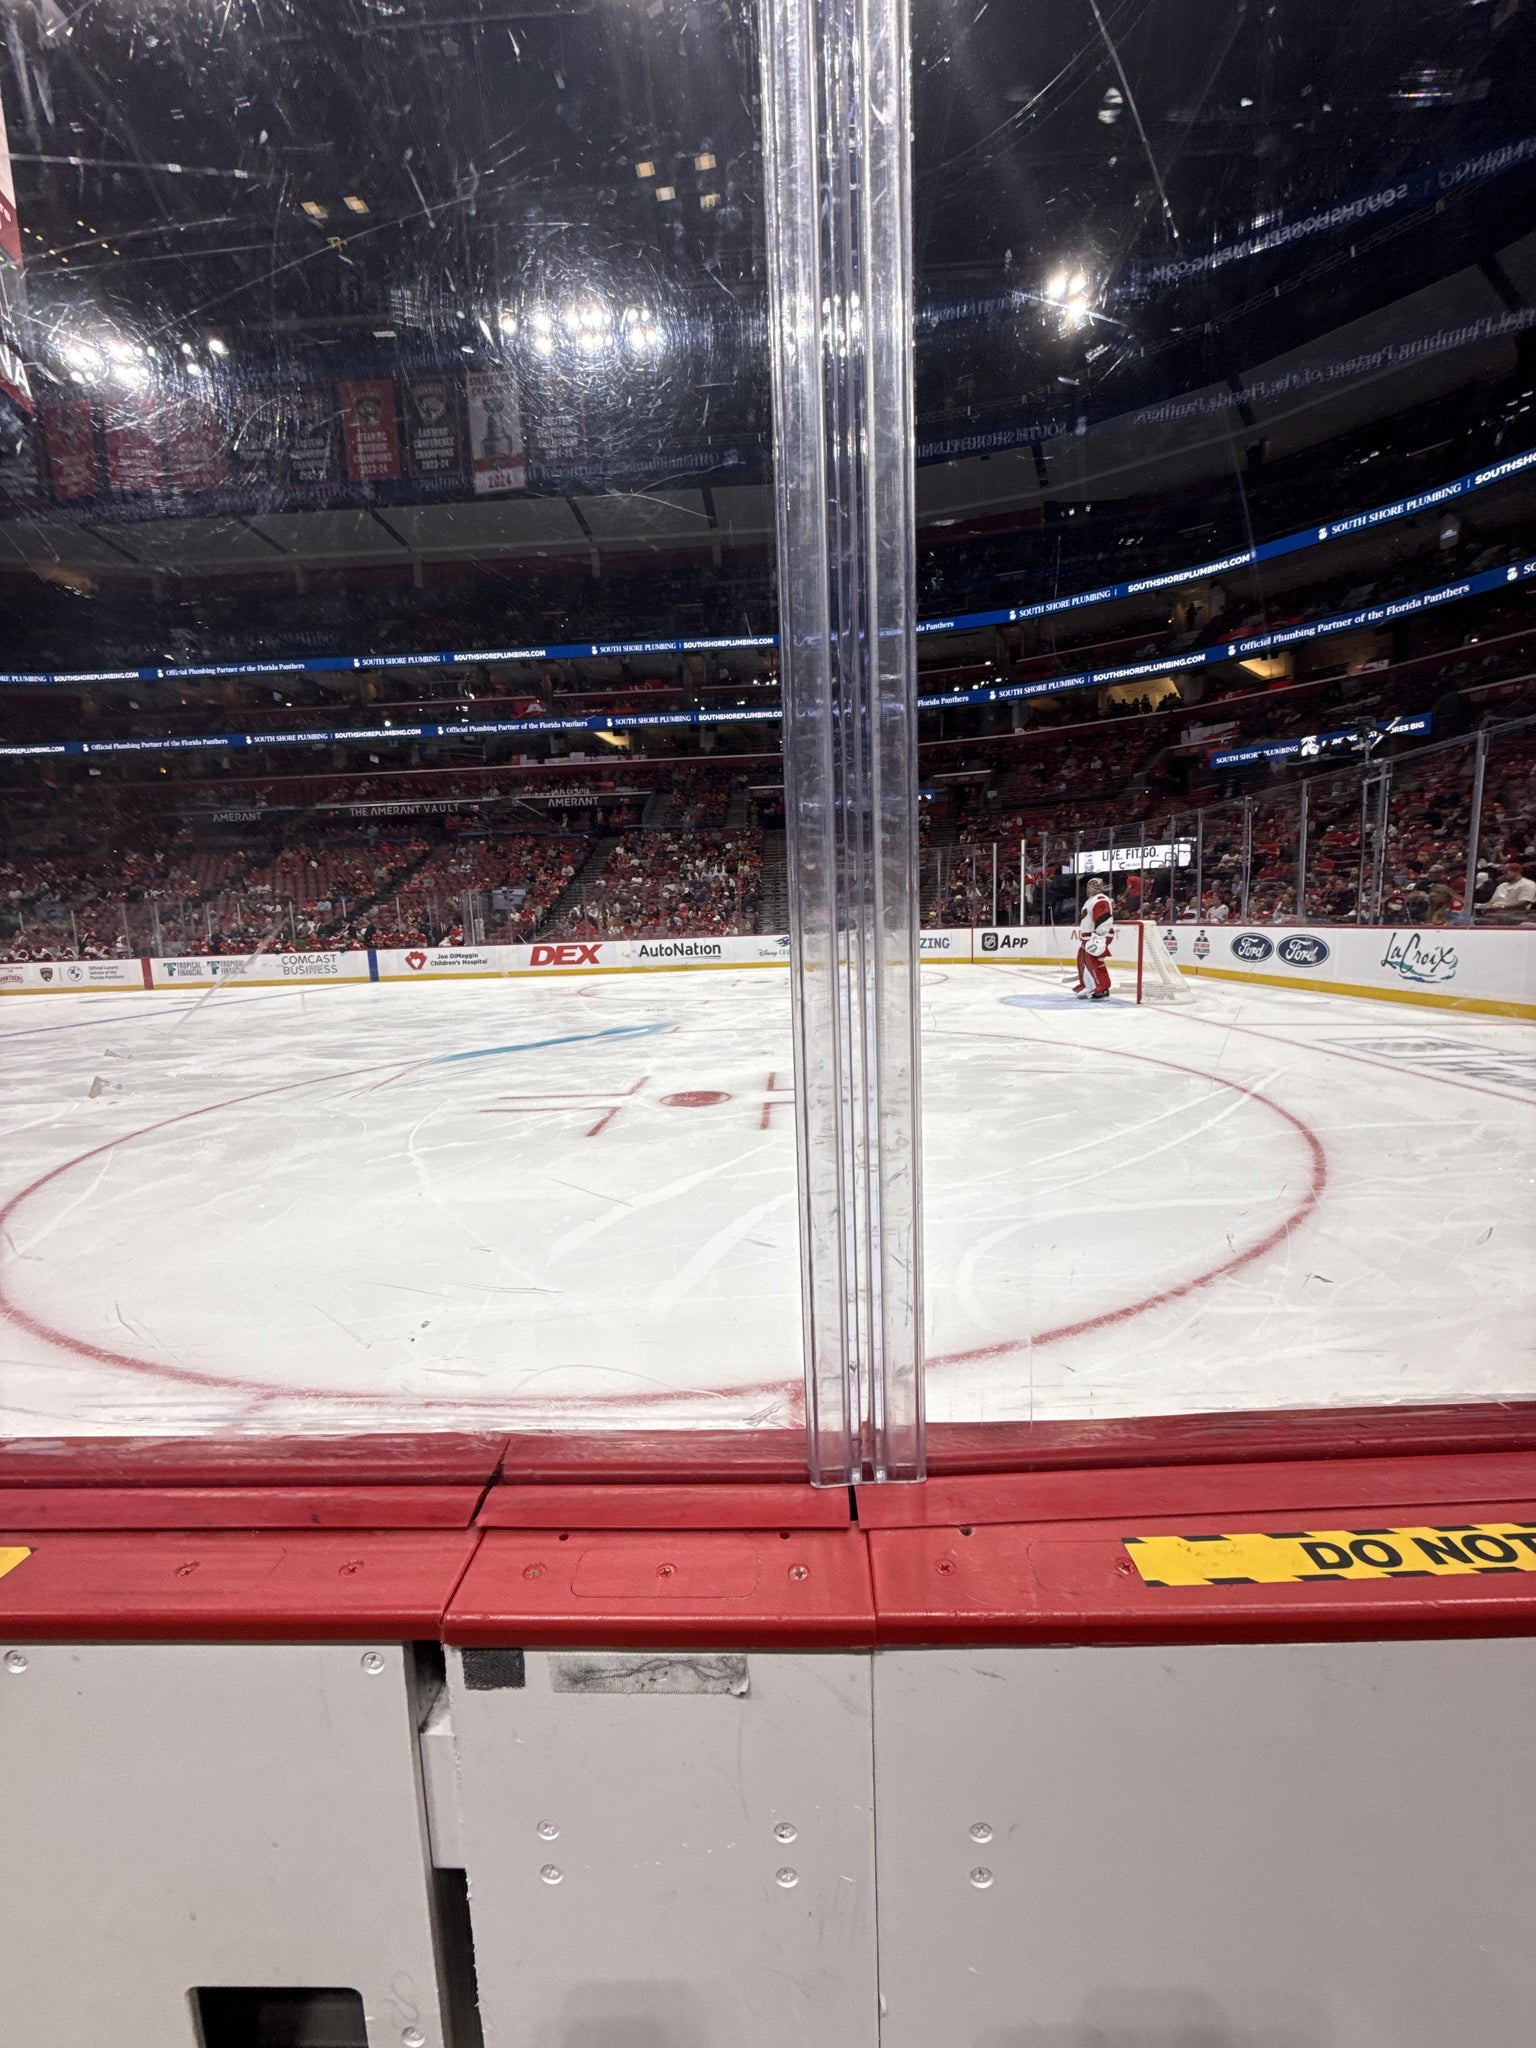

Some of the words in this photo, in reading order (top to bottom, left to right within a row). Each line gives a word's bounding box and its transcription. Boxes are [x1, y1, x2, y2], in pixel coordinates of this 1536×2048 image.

[487, 473, 512, 489] 2024
[1331, 517, 1367, 535] SOUTH
[1368, 505, 1404, 523] SHORE
[1406, 483, 1462, 511] PLUMBING
[1019, 605, 1044, 617] SOUTH
[1045, 599, 1071, 611] SHORE
[1072, 589, 1111, 606] PLUMBING
[1128, 553, 1250, 593] SOUTHSHOREPLUMBING.COM
[1240, 637, 1271, 652] Official
[1273, 626, 1315, 644] Plumbing
[1317, 617, 1352, 633] Partner
[1354, 612, 1366, 623] of
[1368, 608, 1384, 621] the
[1386, 599, 1422, 616] Florida
[1424, 584, 1470, 604] Panthers
[925, 621, 954, 631] Panthers
[600, 645, 621, 653] SOUTH
[623, 644, 643, 652] SHORE
[644, 642, 676, 651] PLUMBING
[683, 638, 773, 649] SOUTHSHOREPLUMBING.COM
[362, 657, 385, 666] SOUTH
[385, 656, 407, 665] SHORE
[407, 655, 441, 664] PLUMBING
[454, 650, 546, 661] SOUTHSHOREPLUMBING.COM
[166, 667, 187, 676] Official
[188, 666, 216, 676] Plumbing
[216, 665, 238, 674] Partner
[239, 665, 246, 673] of
[246, 664, 256, 672] the
[257, 663, 278, 671] Florida
[278, 662, 305, 671] Panthers
[999, 687, 1023, 698] SOUTH
[1024, 683, 1047, 694] SHORE
[1048, 676, 1084, 690] PLUMBING
[1093, 654, 1205, 682] SOUTHSHOREPLUMBING.COM
[53, 671, 139, 682] SOUTHSHOREPLUMBING.COM
[917, 697, 939, 707] Florida
[941, 696, 969, 705] Panthers
[615, 717, 637, 725] SOUTH
[638, 716, 659, 724] SHORE
[660, 715, 691, 724] PLUMBING
[699, 711, 783, 721] SOUTHSHOREPLUMBING.CO
[446, 725, 468, 733] Official
[469, 724, 497, 733] Plumbing
[498, 723, 520, 731] Partner
[521, 722, 528, 730] of
[539, 721, 561, 729] Florida
[562, 720, 588, 728] Panthers
[1410, 721, 1425, 731] BIG
[254, 735, 275, 743] SOUTH
[276, 734, 297, 742] SHORE
[297, 733, 328, 741] PLUMBING
[335, 728, 421, 739] SOUTHSHOREPLUMBING.COM
[91, 743, 112, 751] Official
[113, 742, 140, 750] Plumbing
[203, 738, 228, 746] Panthers
[1216, 754, 1239, 765] SOUTH
[1239, 751, 1260, 762] SHOR
[548, 796, 599, 807] AMERANT
[212, 811, 262, 822] AMERANT
[350, 807, 368, 817] THE
[370, 805, 421, 816] AMERANT
[423, 803, 460, 813] VAULT
[1143, 846, 1159, 858] GO.
[638, 942, 721, 958] AutoNation
[920, 937, 950, 949] ZING
[281, 954, 337, 965] COMCAST
[449, 952, 479, 961] DiMaggio
[530, 944, 603, 966] DEX
[757, 948, 778, 958] Disney
[430, 959, 461, 967] Children's
[462, 958, 488, 966] Hospital
[283, 965, 338, 975] BUSINESS
[1299, 1538, 1403, 1570] DO
[1410, 1533, 1536, 1565] NOT
